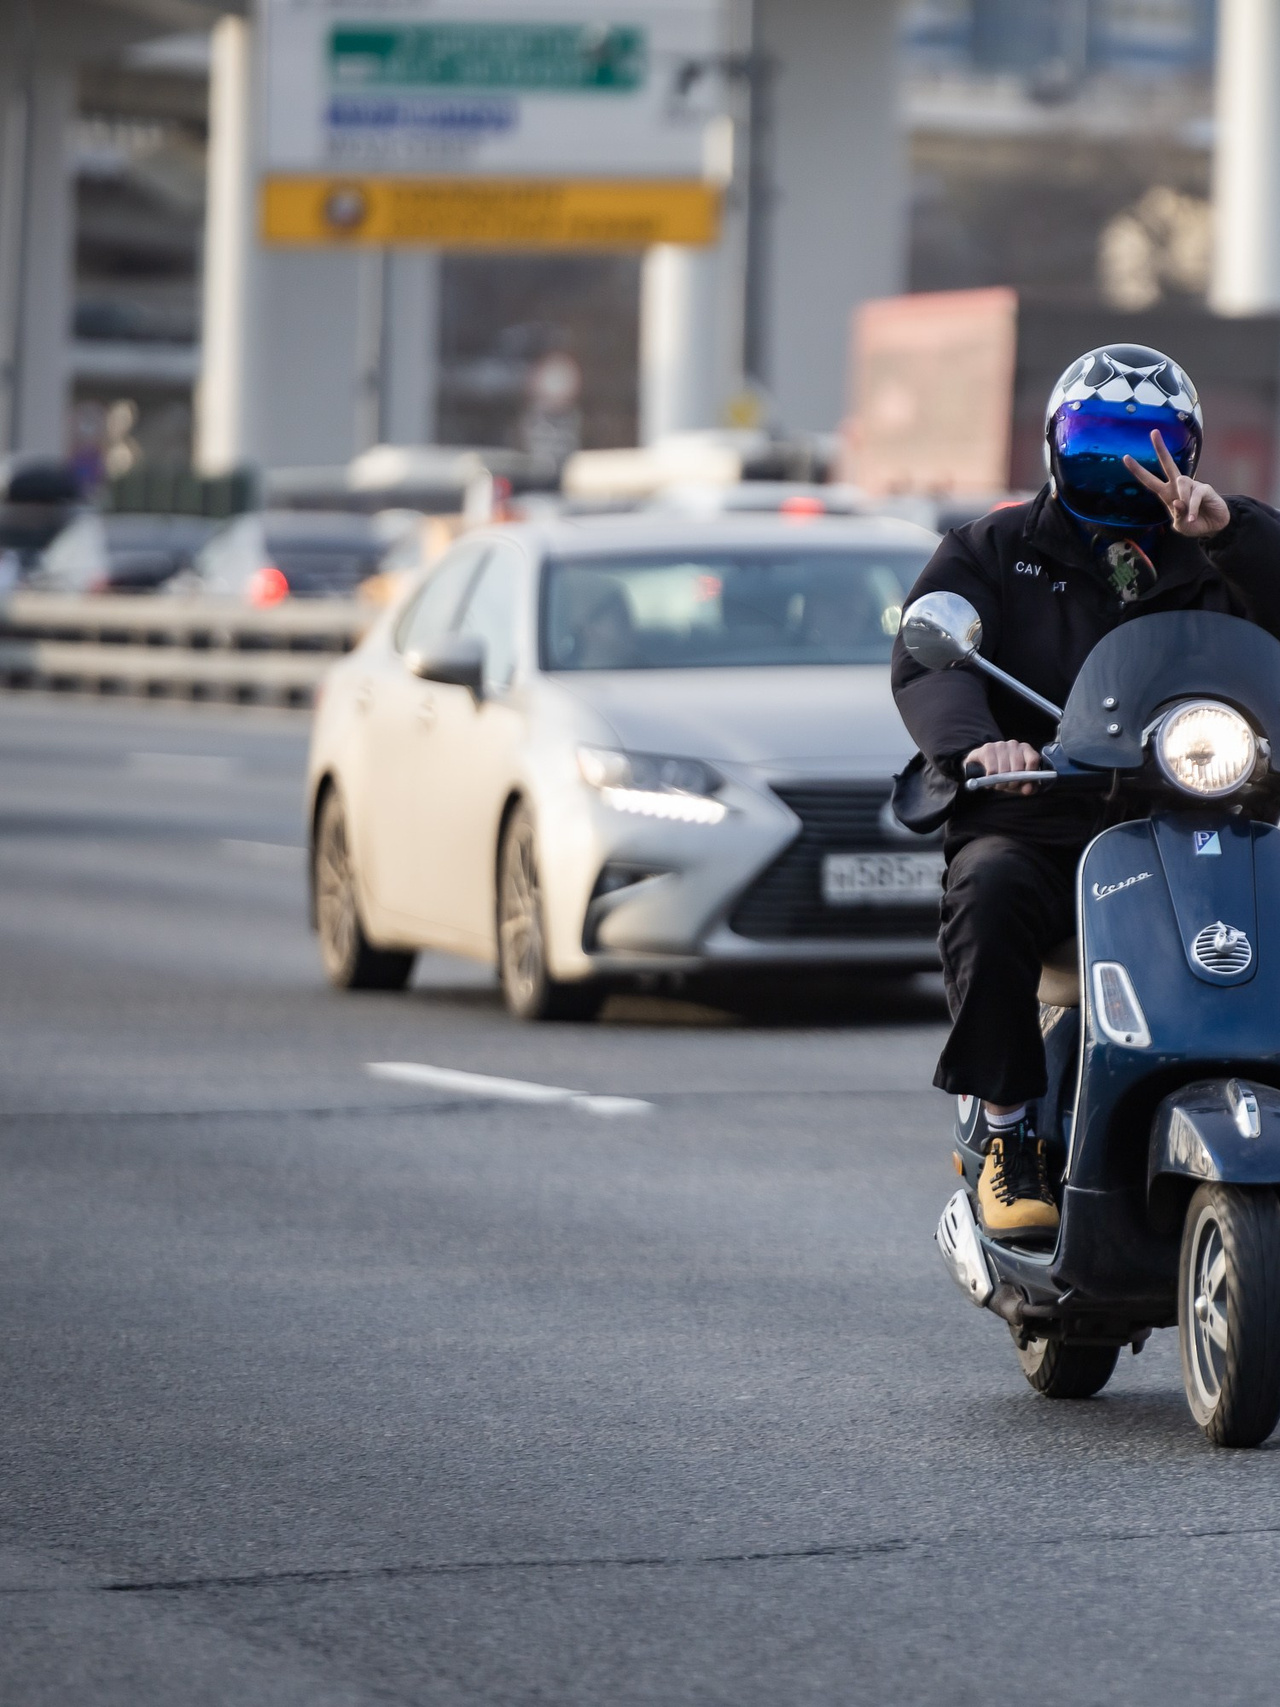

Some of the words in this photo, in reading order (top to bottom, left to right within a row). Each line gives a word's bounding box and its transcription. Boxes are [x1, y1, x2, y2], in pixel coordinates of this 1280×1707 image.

[1015, 561, 1042, 576] CAV
[1197, 832, 1210, 846] P
[1092, 872, 1154, 901] Vespa
